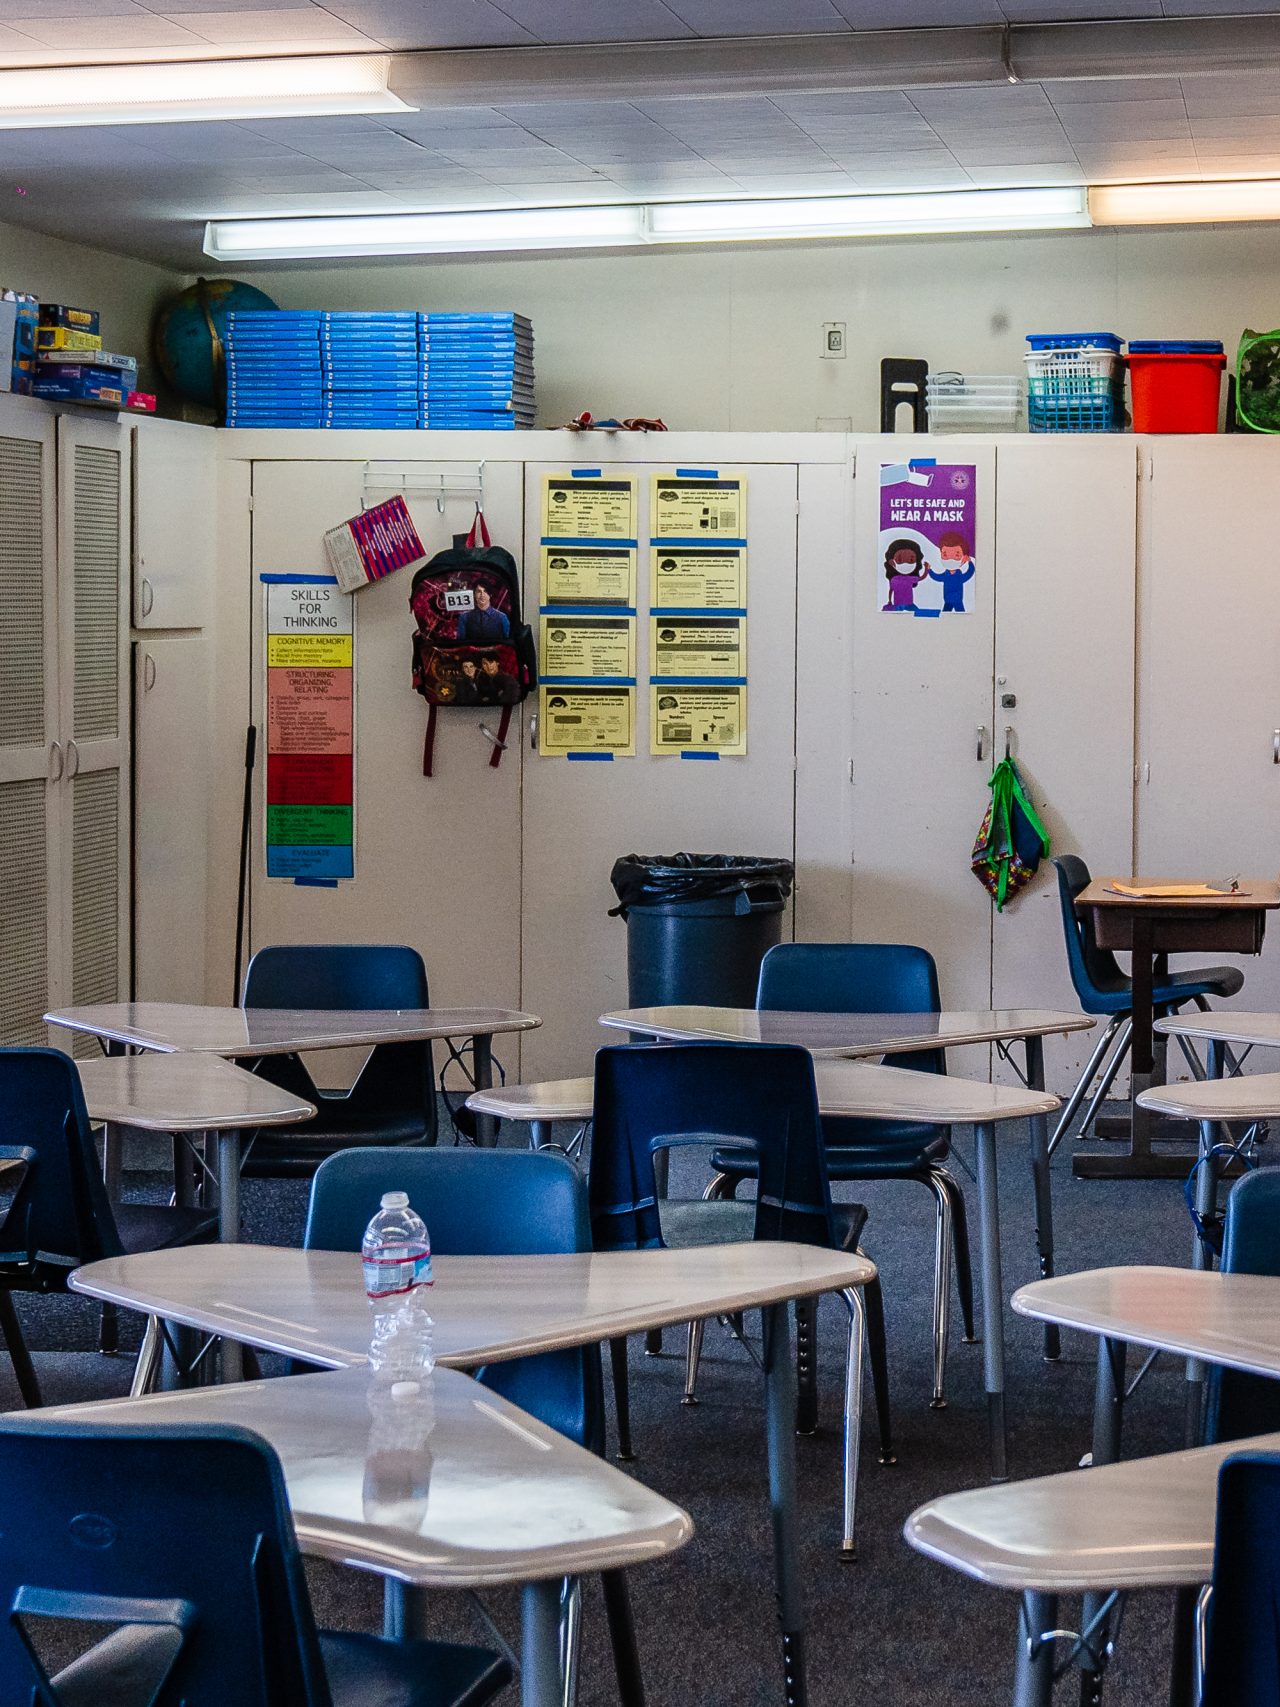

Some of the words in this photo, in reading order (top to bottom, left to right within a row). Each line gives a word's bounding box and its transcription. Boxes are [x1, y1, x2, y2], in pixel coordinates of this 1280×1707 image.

[890, 498, 912, 508] LET'S
[913, 498, 925, 508] BE
[926, 498, 946, 508] SAFE
[947, 499, 965, 508] AND
[891, 510, 920, 522] WEAR
[923, 510, 931, 522] A
[933, 510, 964, 522] MASK
[291, 589, 330, 601] SKILLS
[447, 595, 471, 607] B13
[299, 603, 322, 614] FOR
[283, 616, 338, 628] THINKING
[277, 637, 315, 645] COGNITIVE
[316, 637, 346, 645] MEMORY
